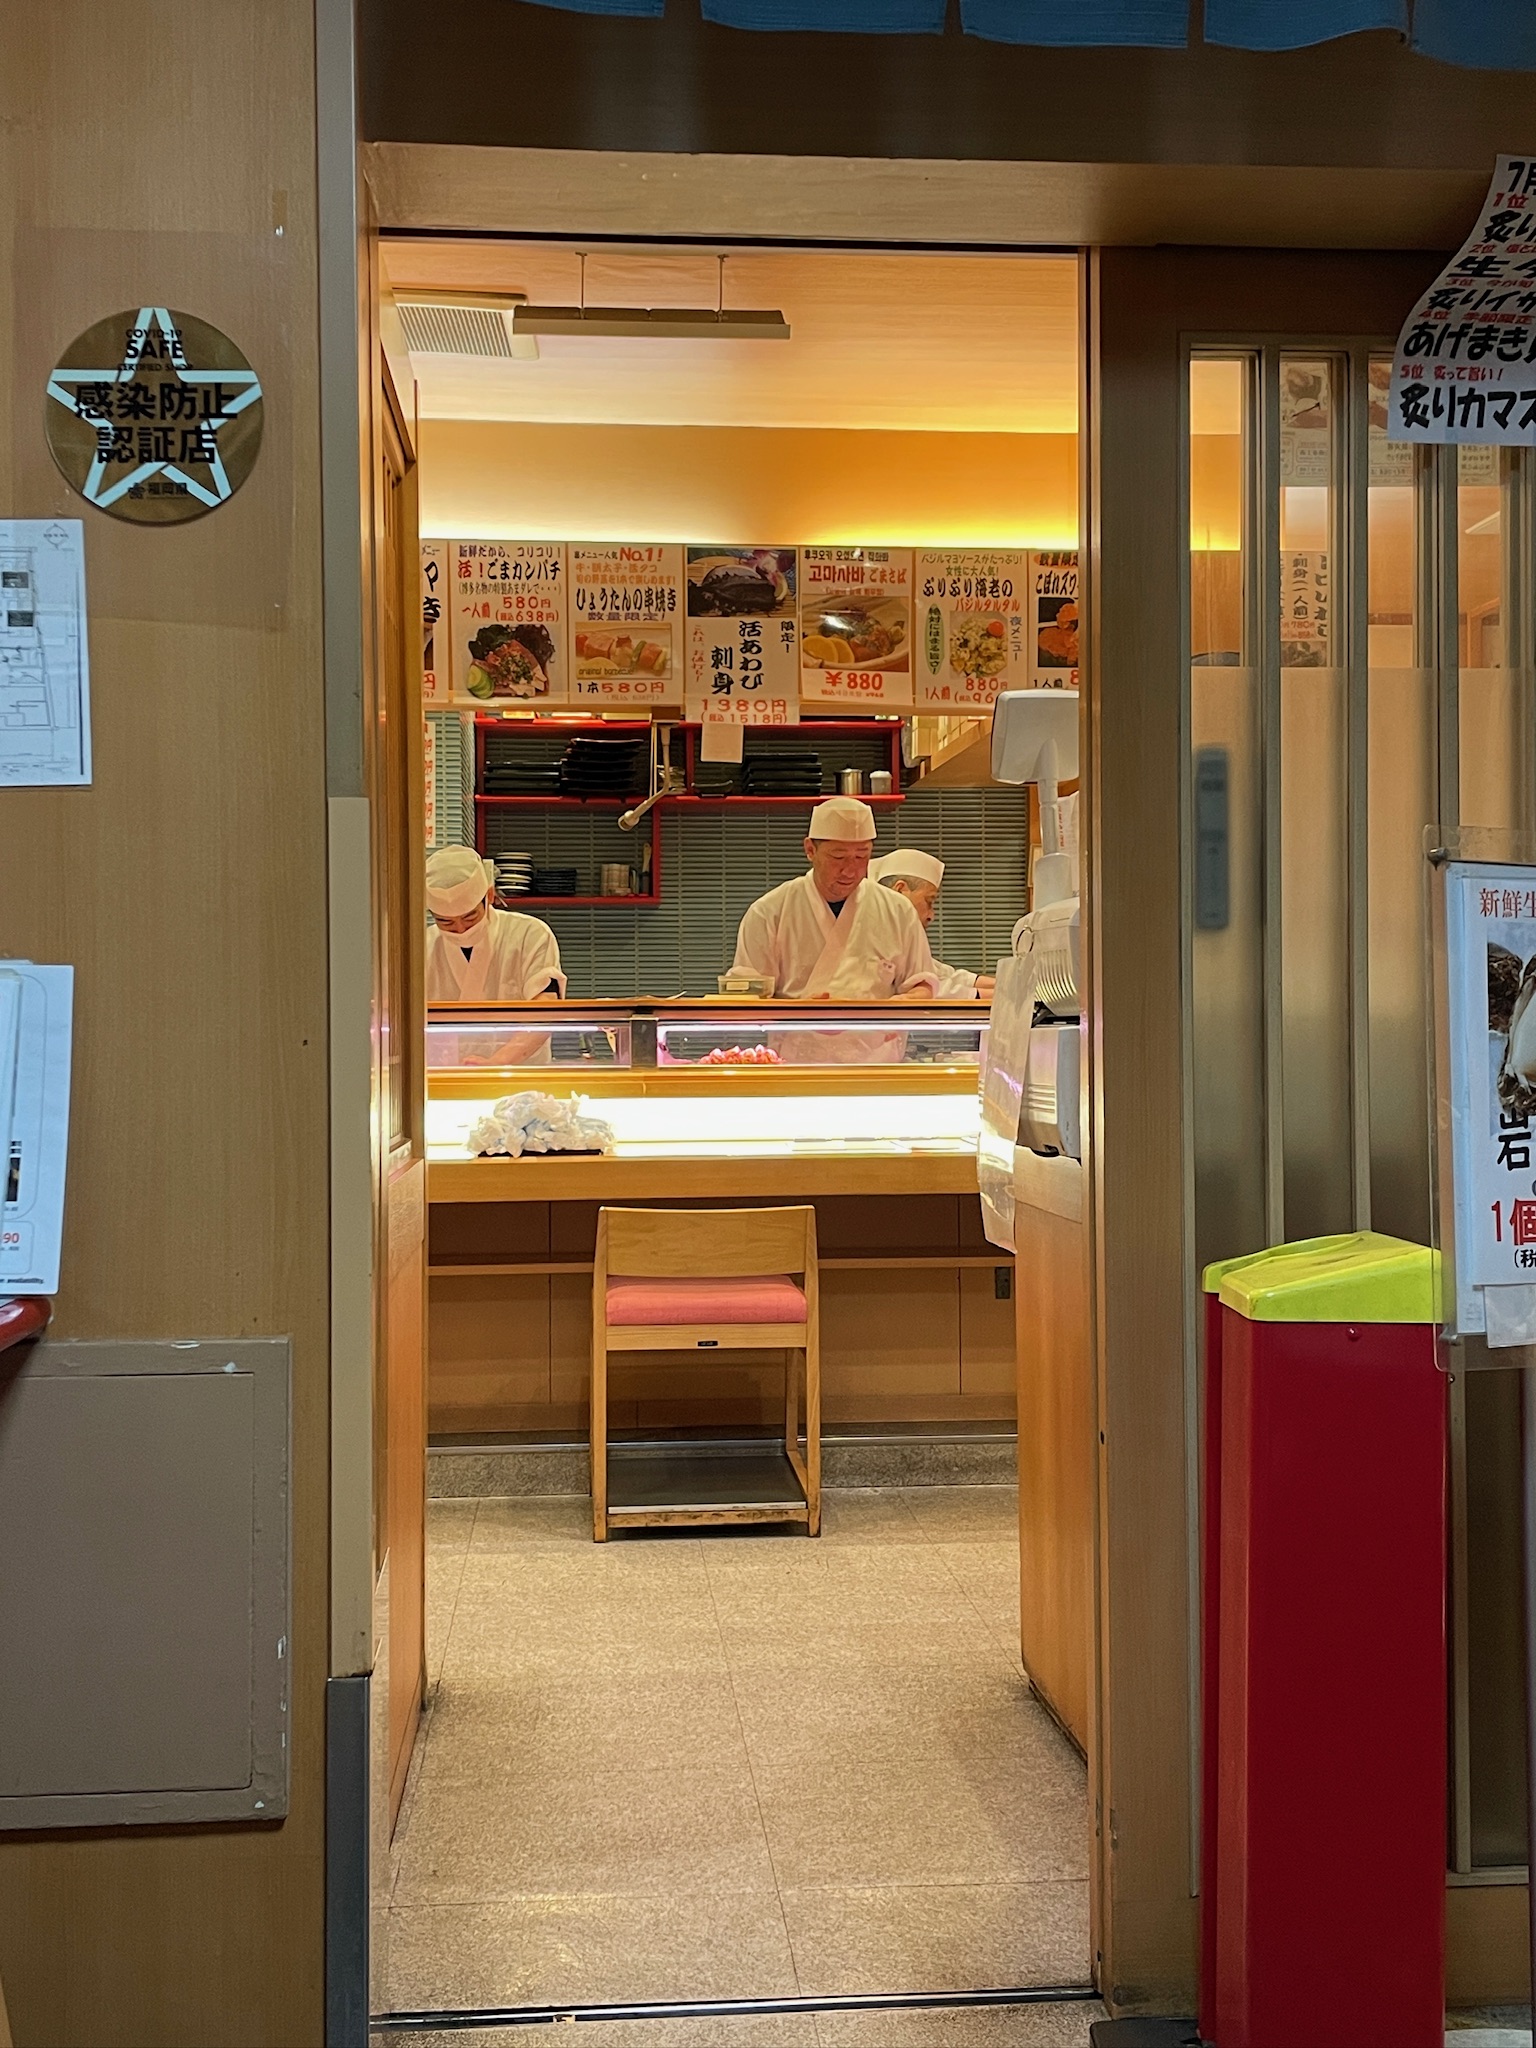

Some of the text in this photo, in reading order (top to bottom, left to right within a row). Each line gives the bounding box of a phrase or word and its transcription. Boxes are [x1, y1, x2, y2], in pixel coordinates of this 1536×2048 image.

[1493, 193, 1528, 208] 1位
[126, 329, 182, 338] COVID-19
[126, 340, 183, 358] SAFE
[1400, 364, 1423, 380] 5位
[75, 382, 238, 420] 感染防止
[97, 426, 217, 464] 認証店
[808, 565, 865, 583] 고마사바
[739, 620, 764, 690] 活あわび
[711, 645, 734, 695] 刺身
[702, 699, 786, 713] 1380円
